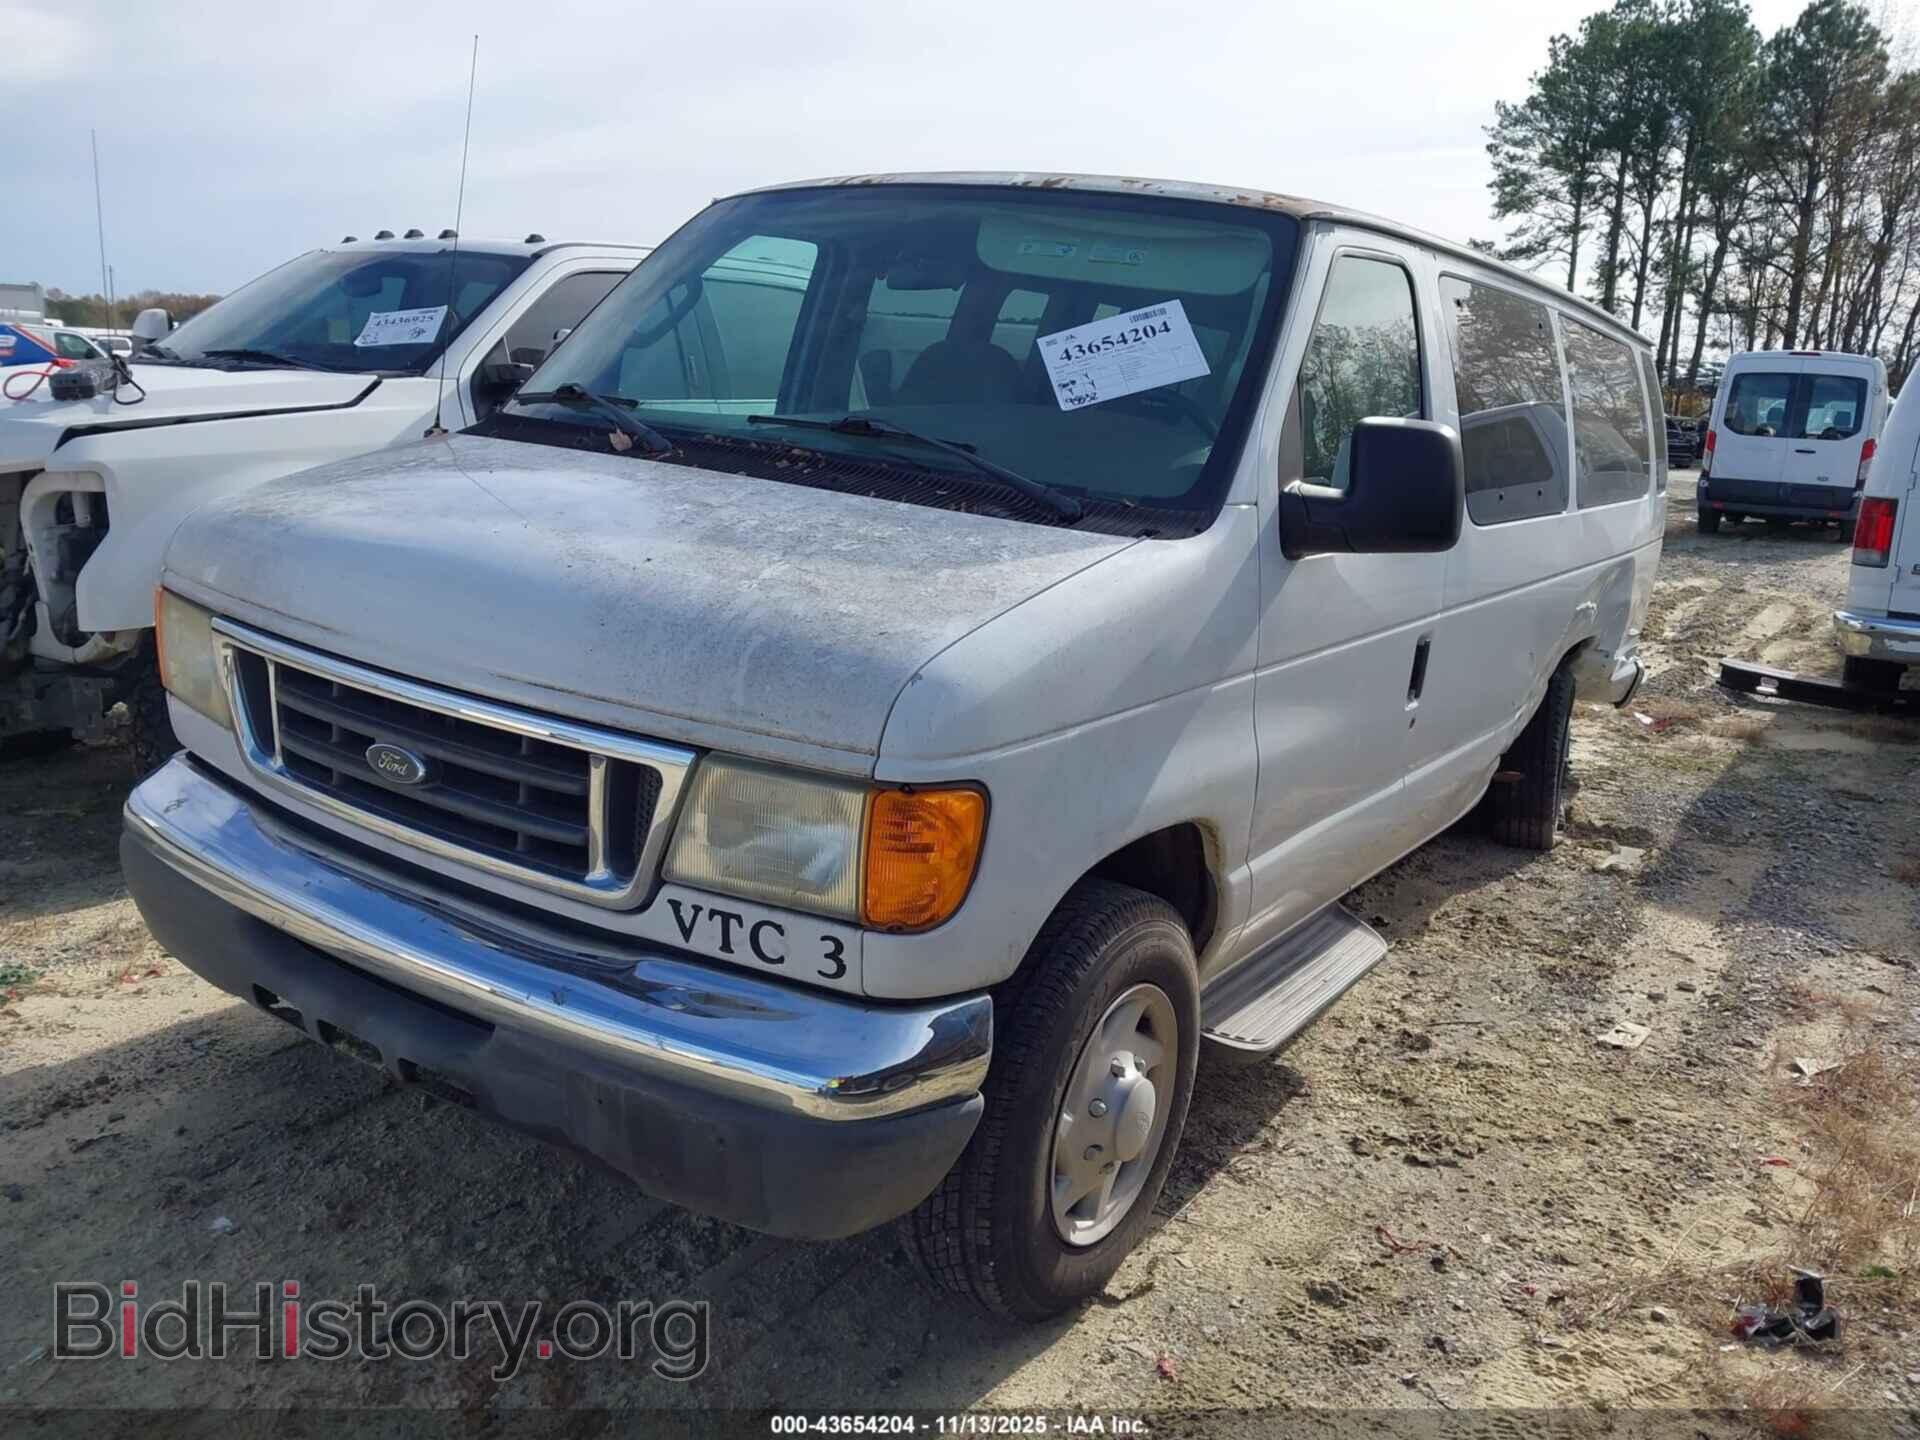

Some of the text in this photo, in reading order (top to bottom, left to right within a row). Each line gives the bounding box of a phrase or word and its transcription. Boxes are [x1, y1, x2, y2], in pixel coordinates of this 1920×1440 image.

[1060, 321, 1171, 362] 43654204
[378, 751, 409, 776] Ford
[667, 898, 847, 979] VTC 3
